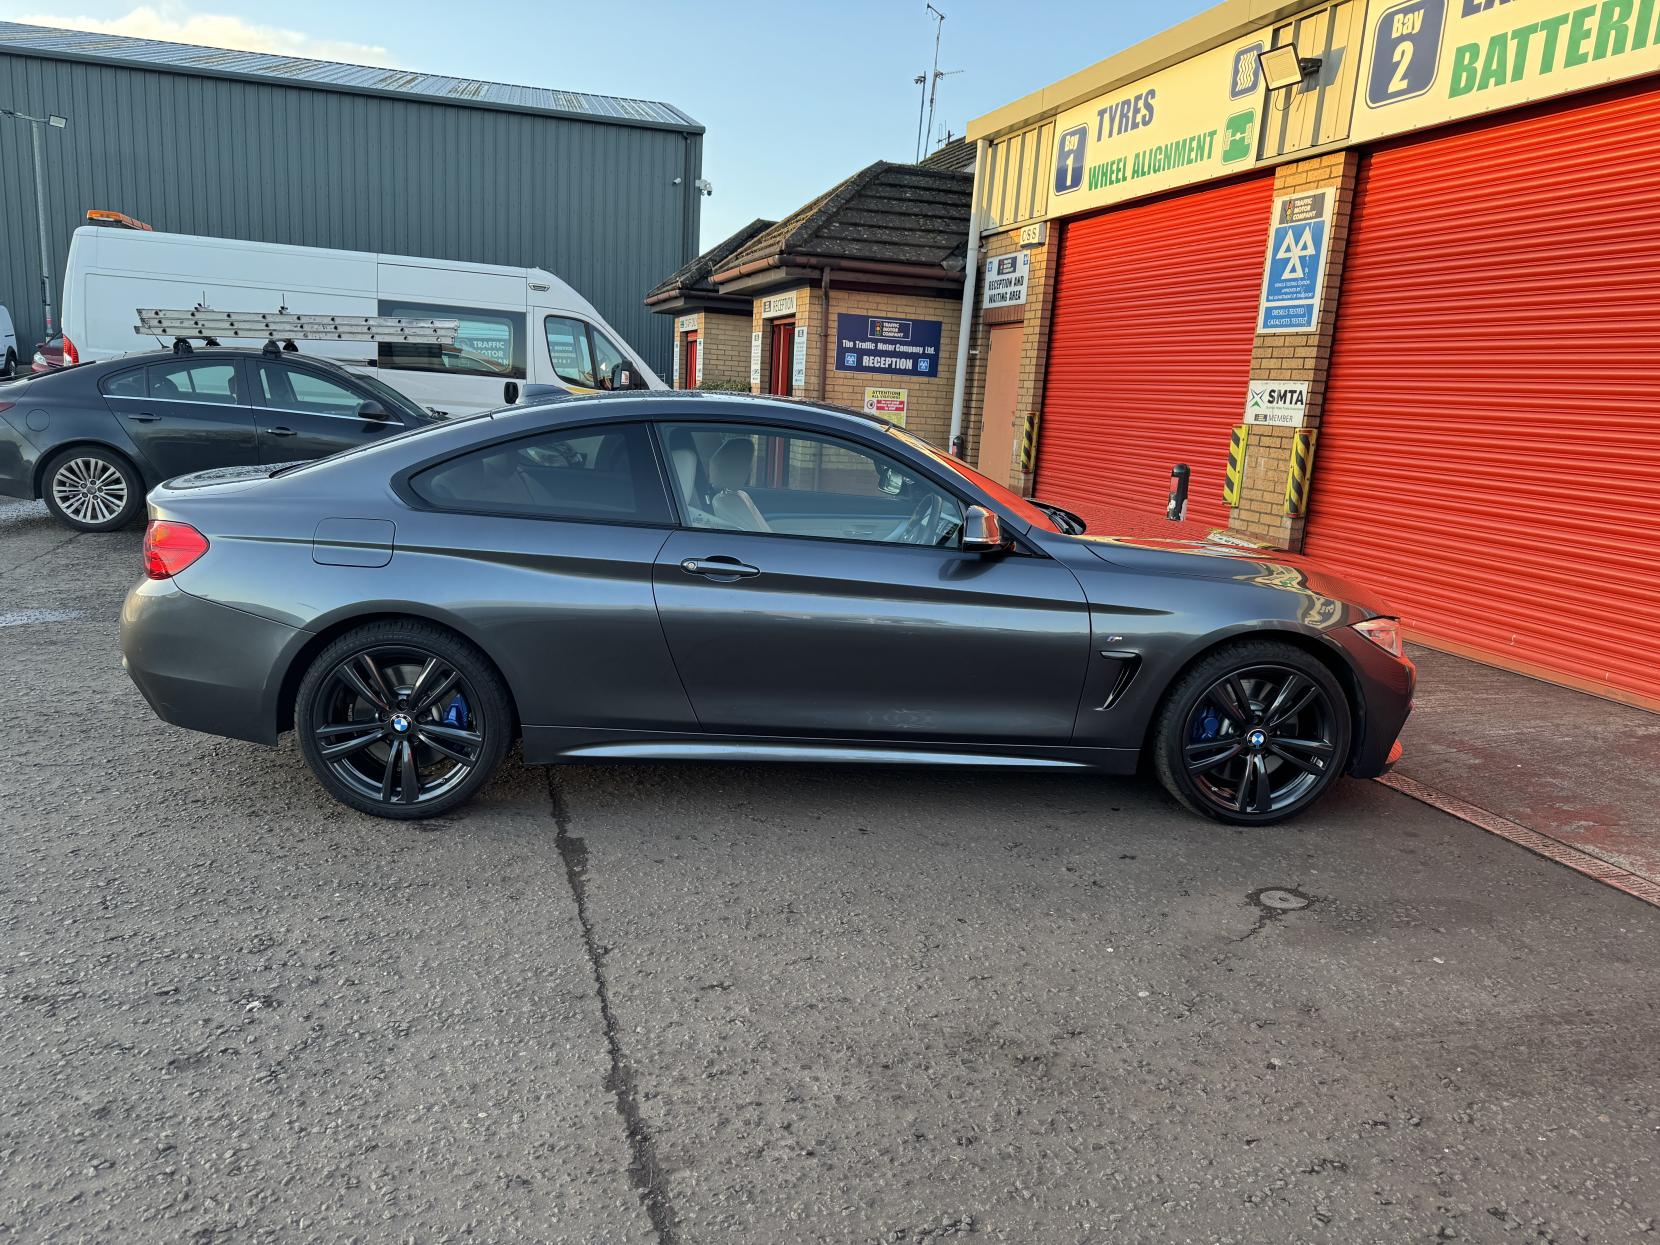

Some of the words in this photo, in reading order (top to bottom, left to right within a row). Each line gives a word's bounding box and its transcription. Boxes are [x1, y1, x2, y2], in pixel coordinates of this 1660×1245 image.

[1392, 9, 1423, 39] Bay
[1448, 0, 1660, 99] BATTERI
[1387, 41, 1414, 94] 2
[1097, 89, 1155, 142] TYRES
[1065, 134, 1079, 152] Bay
[1089, 156, 1127, 191] WHEEL
[1131, 129, 1217, 179] ALIGNMENT
[1066, 153, 1074, 187] 1
[989, 277, 1012, 291] RECEPTION
[1014, 275, 1024, 287] AND
[989, 291, 1007, 304] WAITING
[1009, 290, 1021, 301] AREA
[1292, 317, 1307, 325] TESTED
[842, 340, 854, 348] The
[856, 340, 875, 350] Traffic
[877, 343, 895, 351] Motor
[895, 344, 923, 354] Company
[925, 346, 936, 354] Ltd.
[862, 355, 913, 370] RECEPTION
[1267, 389, 1304, 405] SMTA
[1268, 414, 1293, 423] MEMBER
